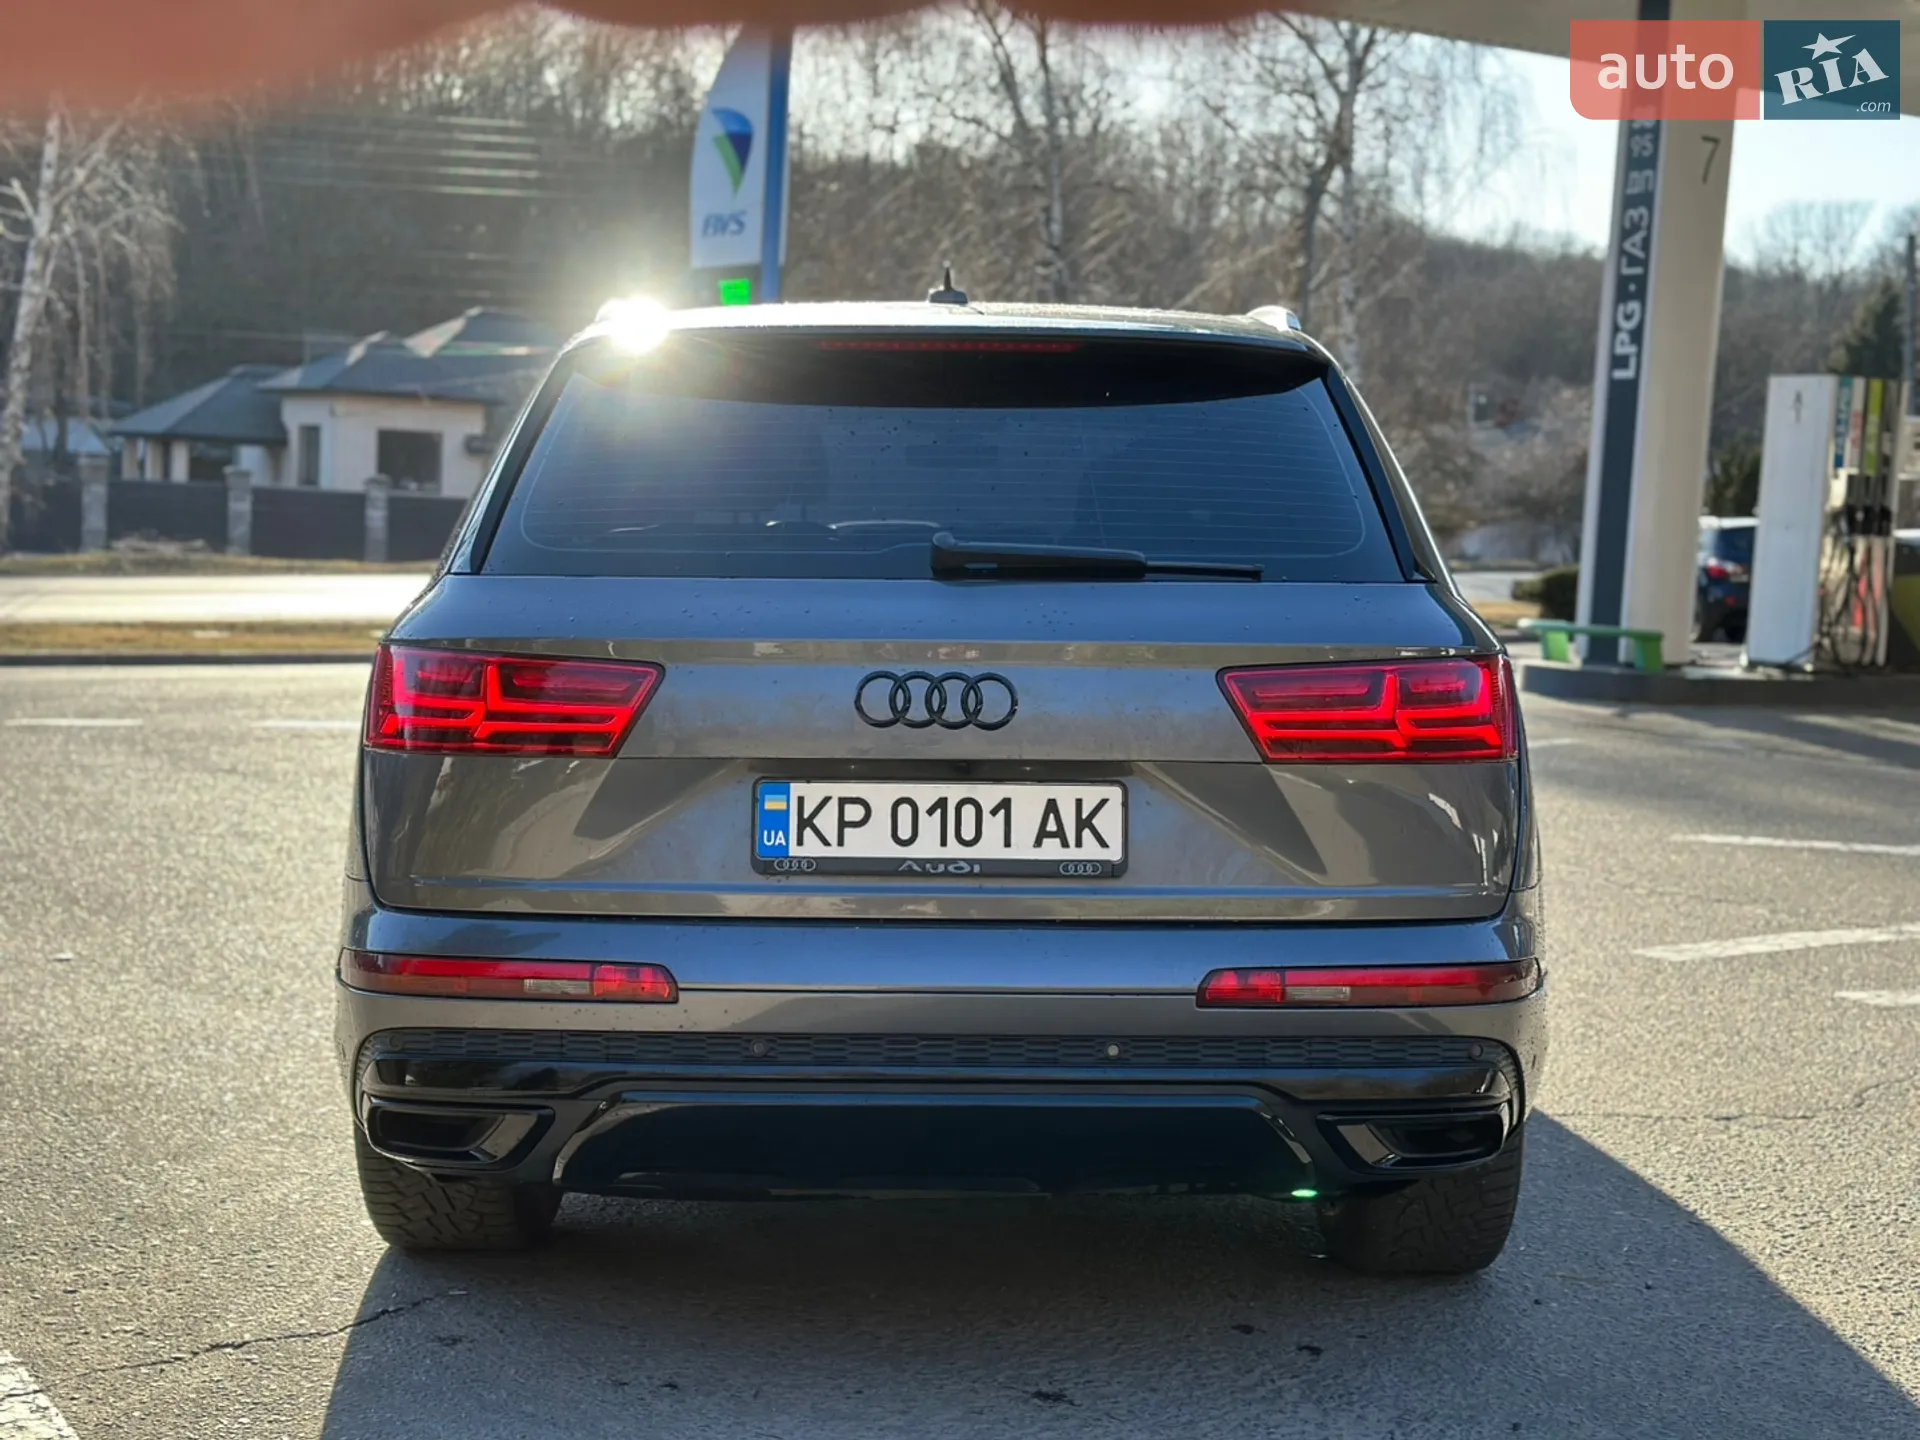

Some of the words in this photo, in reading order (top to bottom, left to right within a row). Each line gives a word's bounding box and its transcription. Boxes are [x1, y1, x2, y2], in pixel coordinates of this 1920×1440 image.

[1620, 205, 1650, 276] ГАЗ
[1611, 302, 1642, 380] LPG
[763, 830, 786, 847] UA
[796, 796, 872, 848] KP
[890, 797, 1012, 848] 0101
[1033, 798, 1111, 850] AK
